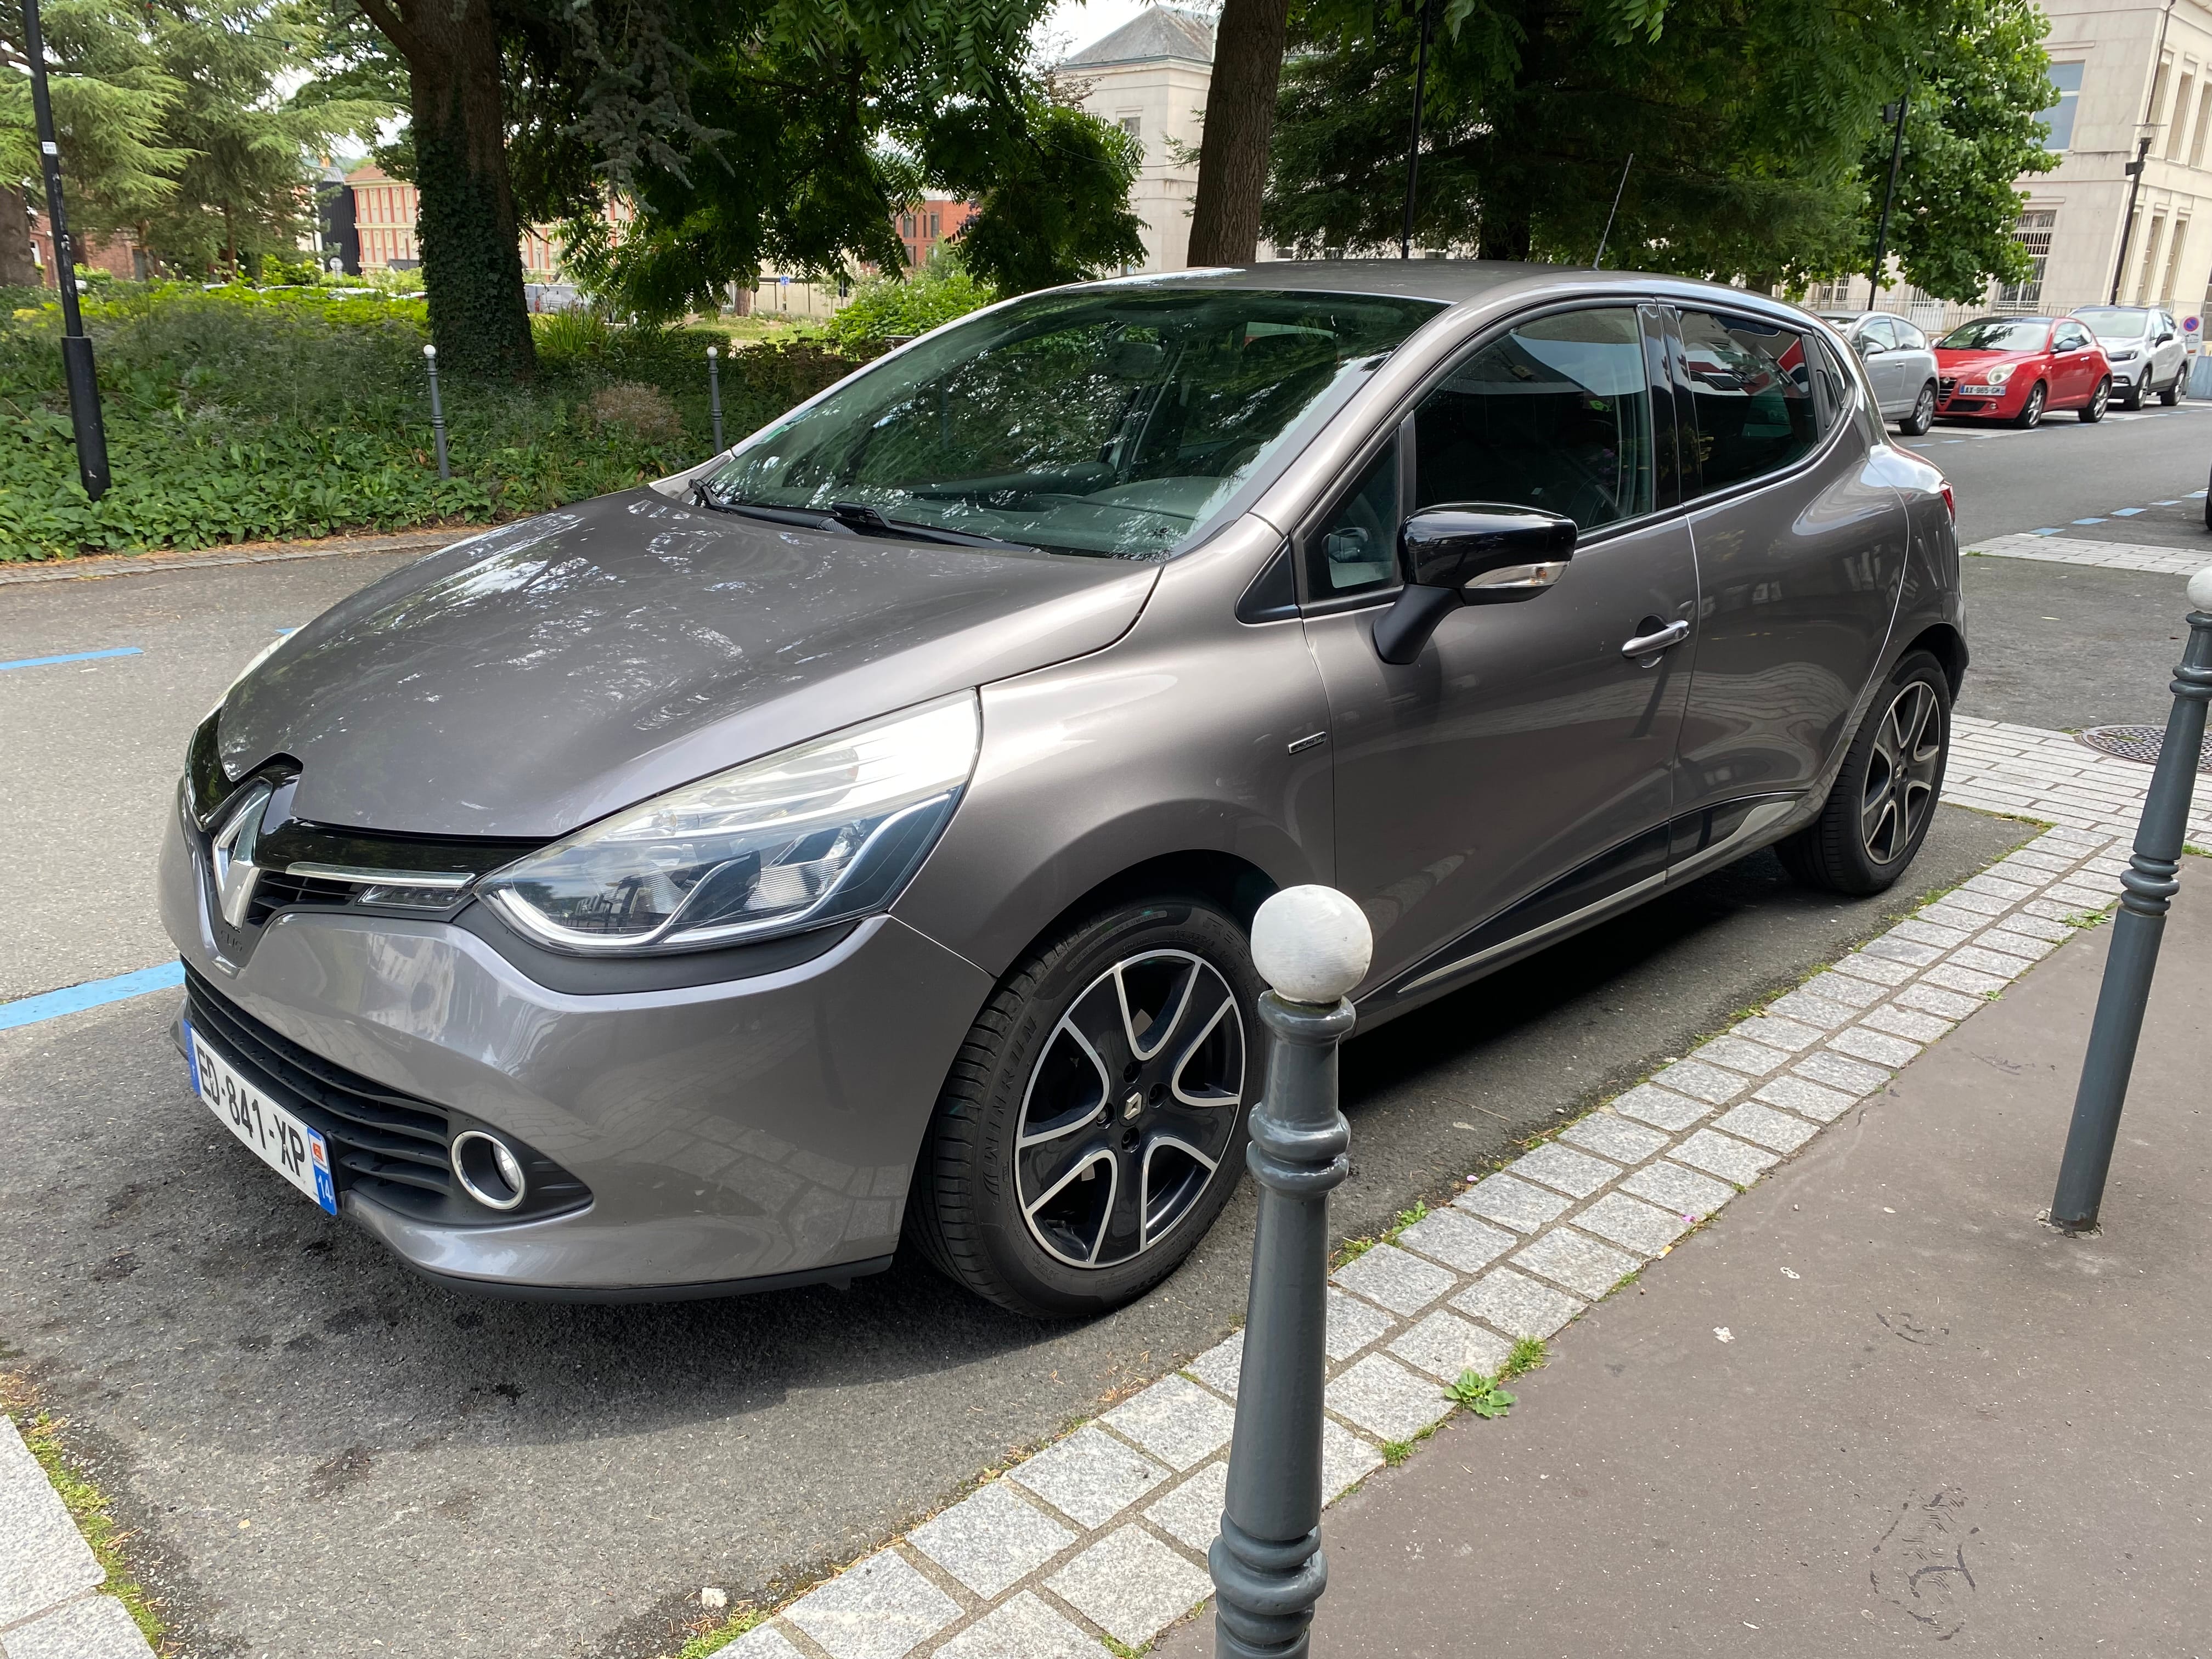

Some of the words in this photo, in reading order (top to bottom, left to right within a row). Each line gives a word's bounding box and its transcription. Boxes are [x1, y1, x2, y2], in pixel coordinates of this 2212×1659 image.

[221, 930, 242, 952] CLIO
[196, 1043, 305, 1177] ED-841-XP
[318, 1175, 333, 1204] 14
